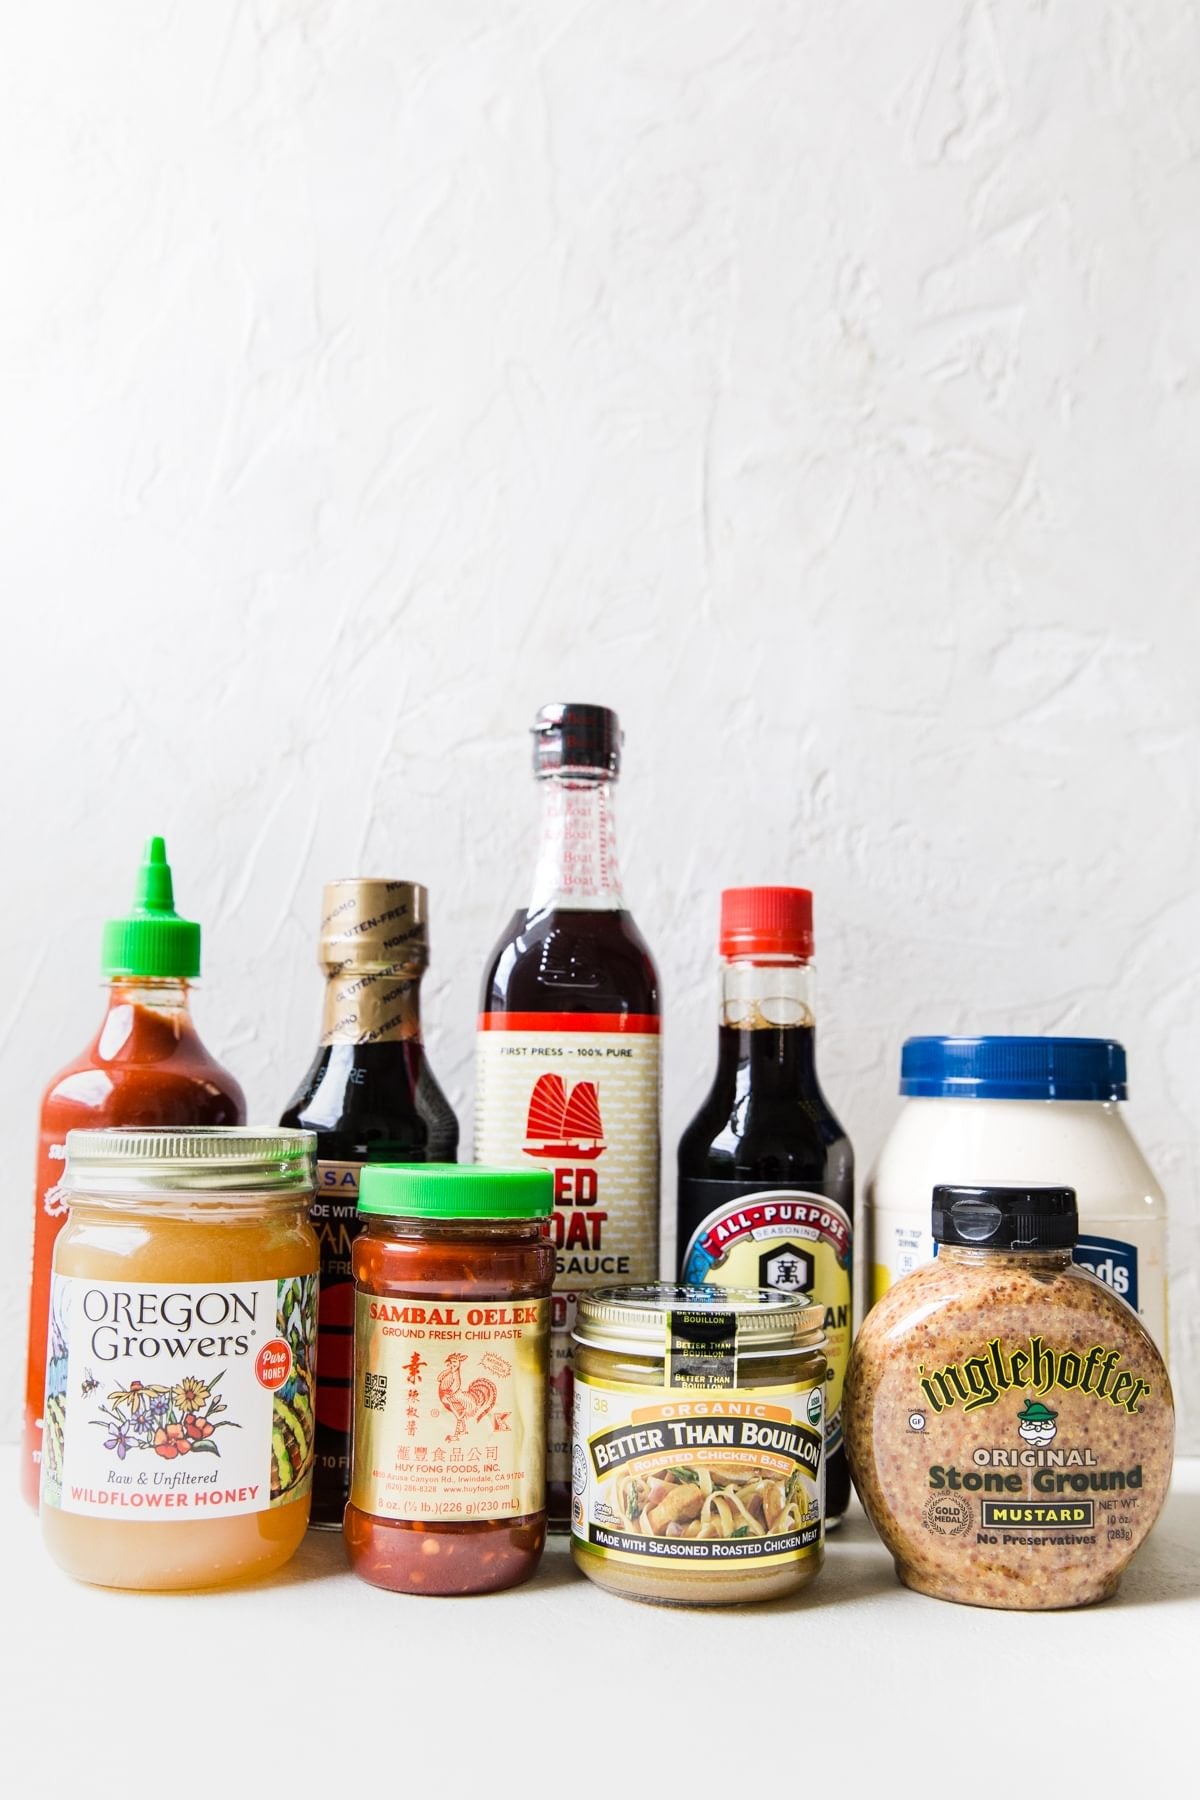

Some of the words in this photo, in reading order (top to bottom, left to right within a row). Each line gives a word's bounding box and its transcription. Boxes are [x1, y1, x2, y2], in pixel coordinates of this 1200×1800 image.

[501, 1047, 527, 1056] FIRST
[531, 1047, 563, 1056] PRESS
[577, 1048, 602, 1057] 100%
[606, 1048, 633, 1057] PURE
[756, 1226, 817, 1240] SEASONING
[555, 1256, 630, 1275] SAUCE
[83, 1289, 258, 1332] OREGON
[369, 1302, 460, 1326] SAMBAL
[466, 1306, 538, 1326] OELEK
[683, 1315, 725, 1324] BOUILLON
[382, 1326, 425, 1339] GROUND
[428, 1330, 462, 1340] FRESH
[464, 1331, 491, 1340] CHILI
[494, 1329, 522, 1340] PASTE
[91, 1325, 249, 1361] Growers
[675, 1340, 706, 1349] BETTER
[262, 1350, 286, 1365] Pure
[682, 1349, 724, 1358] BOUILLON
[262, 1366, 286, 1380] HONEY
[674, 1373, 706, 1382] BETTER
[708, 1375, 731, 1384] THAN
[918, 1335, 1151, 1415] inglehoffer
[660, 1404, 767, 1418] ORGANIC
[594, 1428, 665, 1468] BETTER
[668, 1421, 734, 1447] THAN
[740, 1421, 820, 1468] BOUILLON
[634, 1453, 694, 1472] ROASTED
[696, 1449, 757, 1463] CHICKEN
[761, 1454, 791, 1471] BASE
[973, 1448, 1097, 1467] ORIGINAL
[394, 1463, 414, 1472] HUY
[416, 1465, 443, 1474] FONG
[446, 1464, 481, 1474] FOODS,
[483, 1463, 501, 1473] INC.
[107, 1470, 133, 1484] Raw
[136, 1472, 149, 1485] &
[153, 1469, 219, 1489] Unfiltered
[409, 1475, 439, 1484] Canyon
[928, 1465, 1023, 1492] Stone
[1032, 1464, 1143, 1493] Ground
[71, 1486, 188, 1507] WILDFLOWER
[194, 1485, 260, 1506] HONEY
[935, 1506, 961, 1516] GOLD
[1099, 1501, 1118, 1511] NET
[934, 1516, 964, 1524] MEDAL
[993, 1509, 1085, 1522] MUSTARD
[1106, 1516, 1117, 1525] 10
[596, 1530, 620, 1546] MADE
[622, 1538, 646, 1552] WITH
[649, 1541, 709, 1556] SEASONED
[712, 1543, 762, 1557] ROASTED
[763, 1537, 801, 1554] CHICKEN
[801, 1528, 818, 1544] MEAT
[976, 1533, 998, 1546] No
[1002, 1533, 1097, 1546] Preservatives
[1106, 1530, 1134, 1543] (283g)
